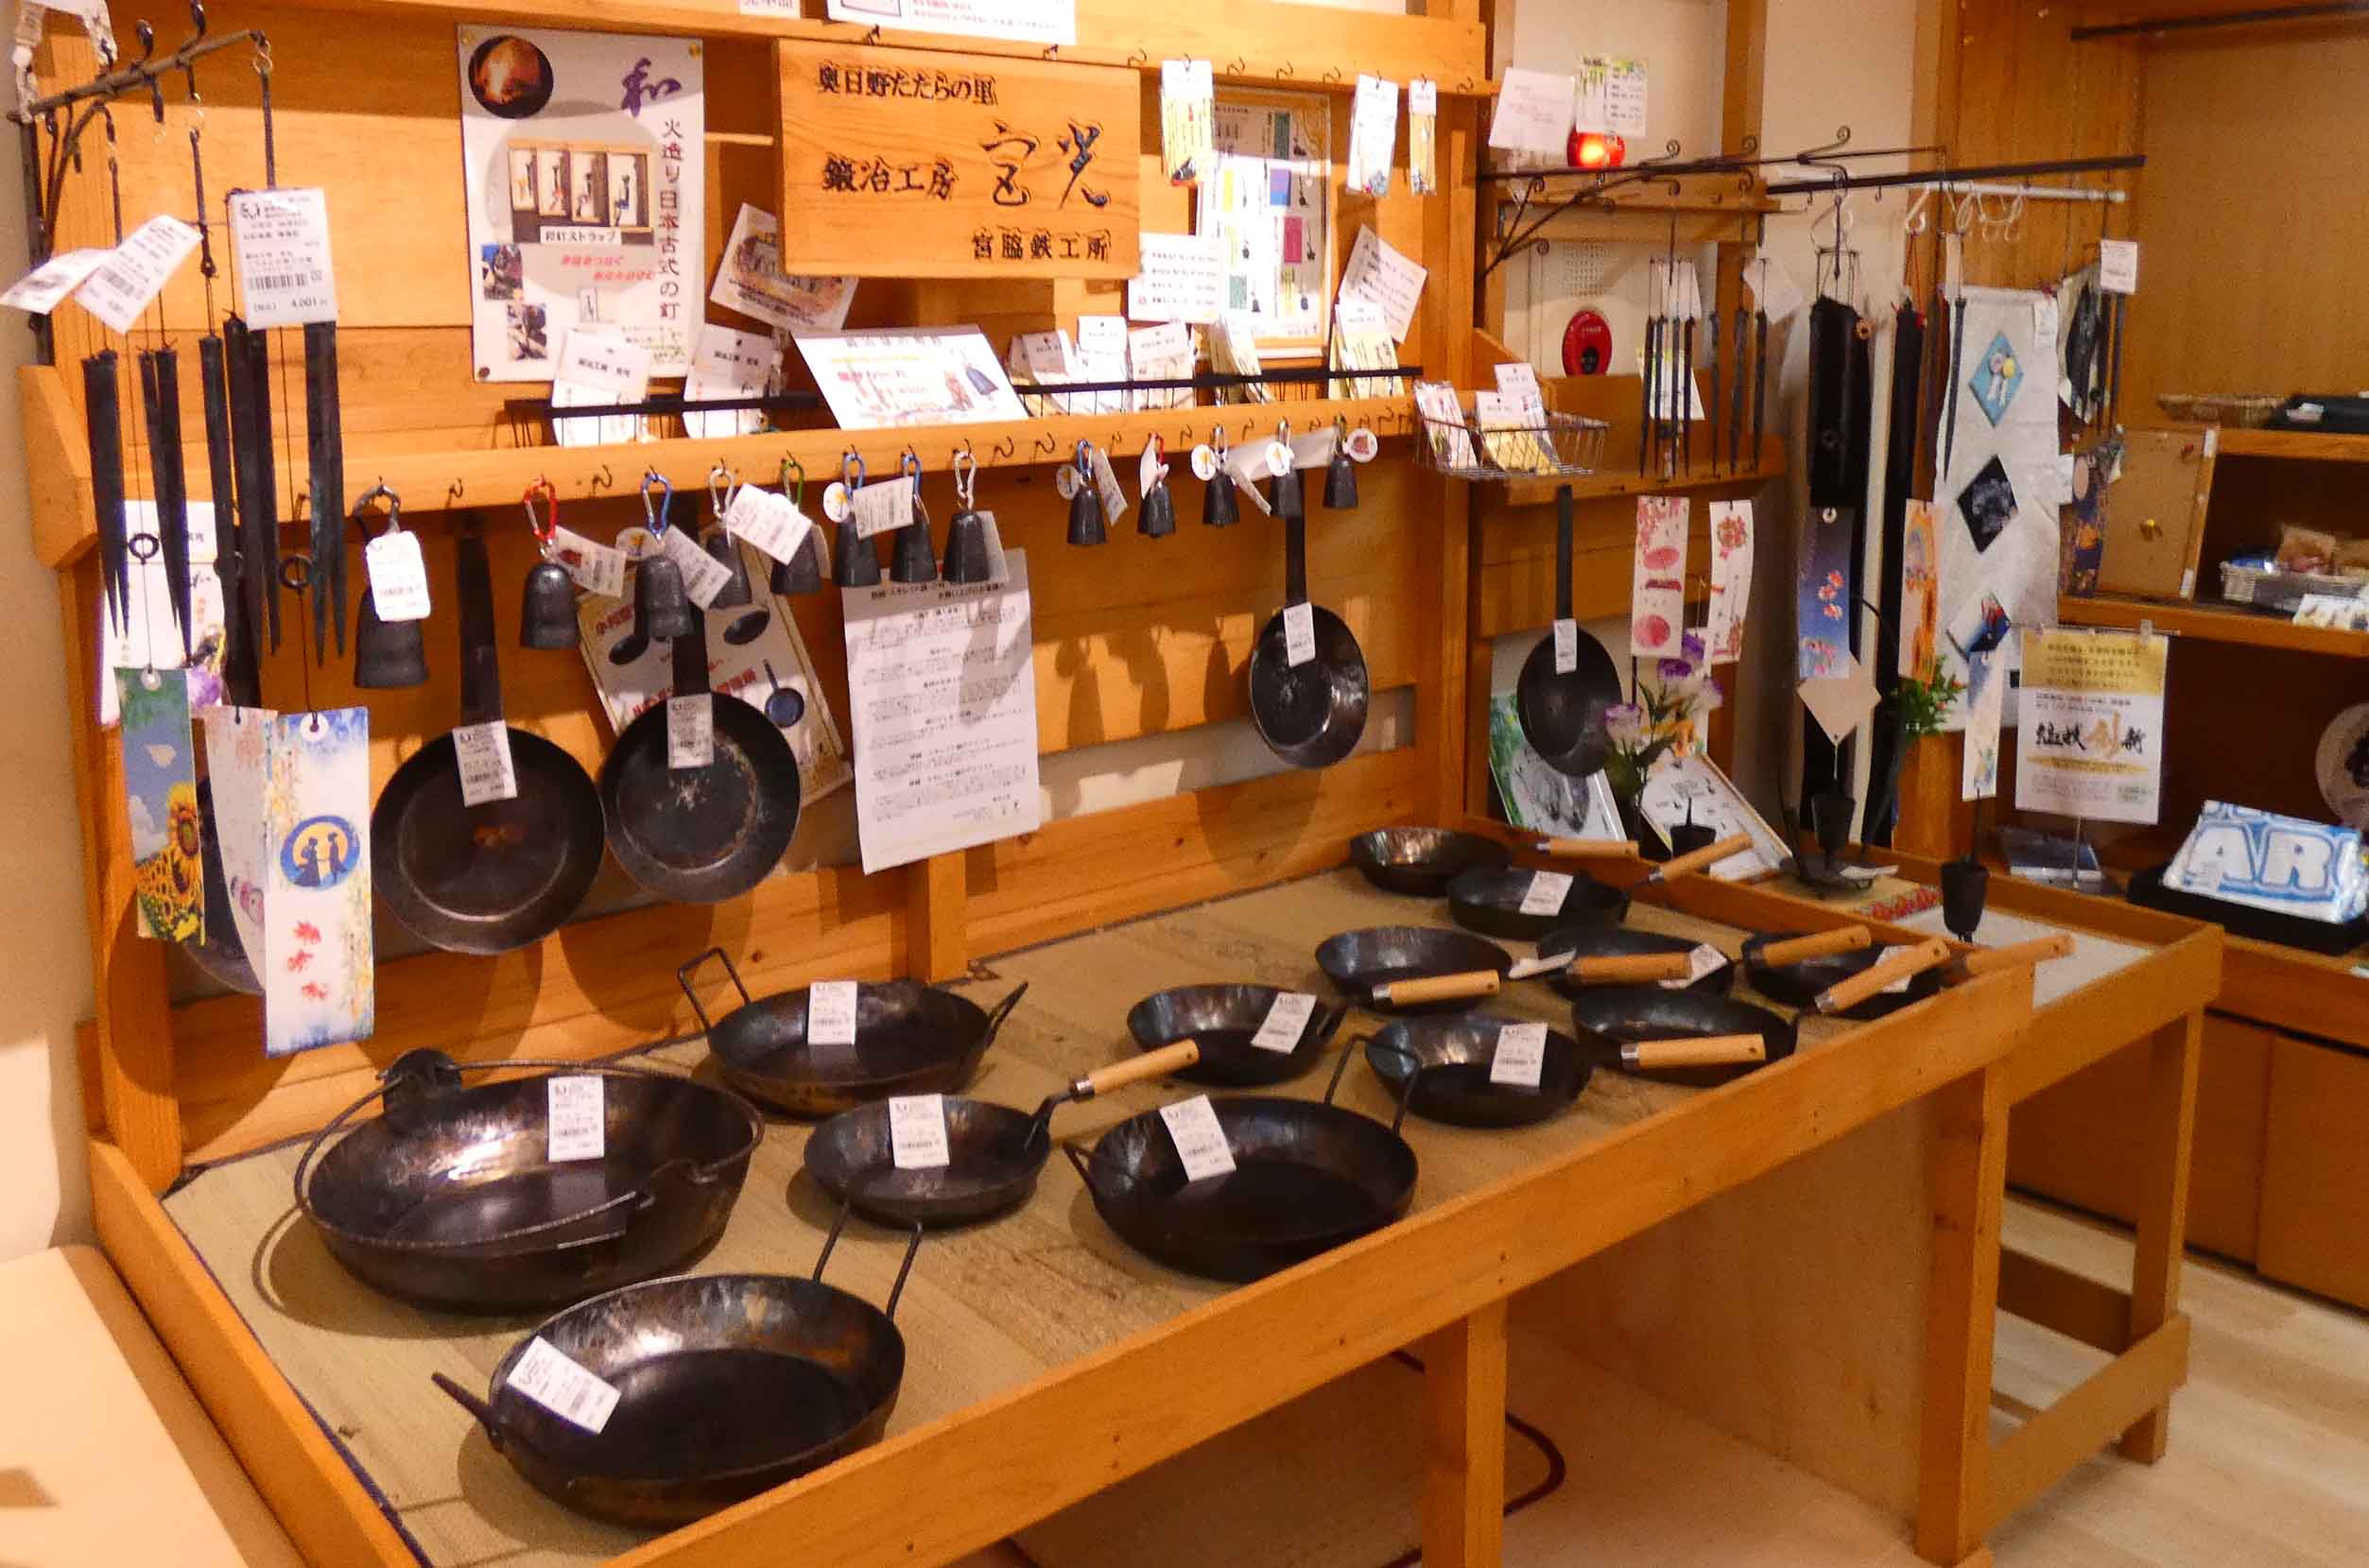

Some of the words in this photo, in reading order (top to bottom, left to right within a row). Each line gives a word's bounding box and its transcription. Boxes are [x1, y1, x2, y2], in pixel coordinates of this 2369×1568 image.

[620, 57, 682, 118] 和
[818, 61, 998, 106] 奥日野たたらの里
[821, 153, 959, 201] 鍛冶工房
[657, 118, 683, 319] 火造り日本古式の釘
